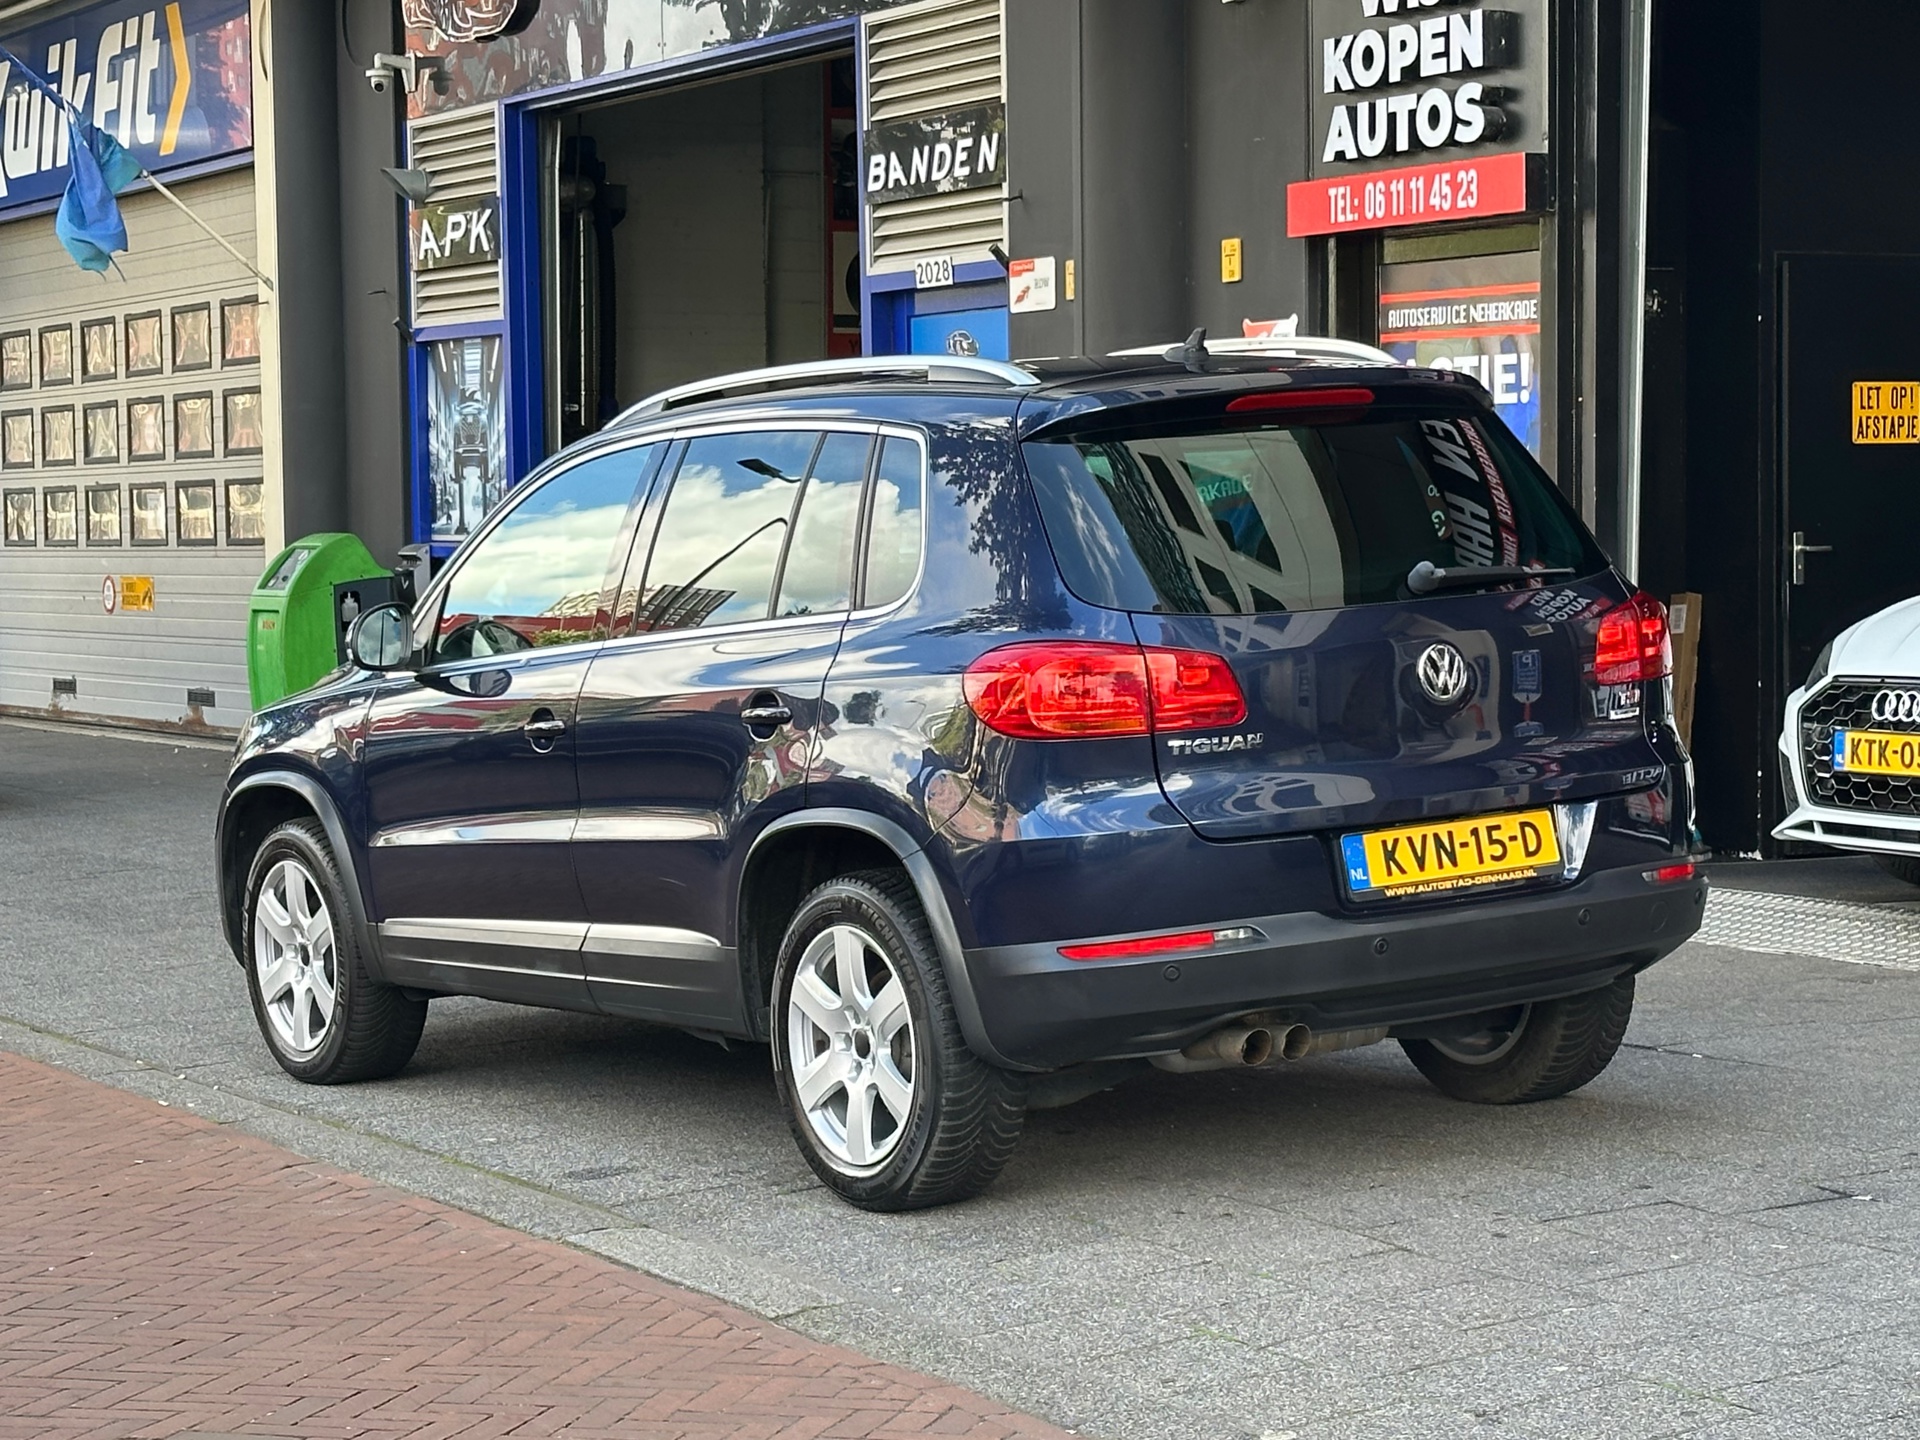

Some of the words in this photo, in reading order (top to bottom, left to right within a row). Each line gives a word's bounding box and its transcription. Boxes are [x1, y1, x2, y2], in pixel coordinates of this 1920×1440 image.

[1323, 8, 1484, 93] KOPEN
[0, 38, 91, 197] wik
[93, 11, 160, 149] Fit
[1322, 82, 1485, 163] AUTOS
[867, 133, 999, 192] BANDEN
[1328, 186, 1359, 224] TEL:
[1364, 181, 1386, 220] 06
[1389, 179, 1404, 216] 11
[1409, 177, 1424, 214] 11
[1429, 172, 1451, 211] 45
[1456, 169, 1478, 208] 23
[419, 209, 493, 261] APK
[916, 259, 951, 286] 2028
[1469, 299, 1538, 324] NEHERKADE
[1859, 386, 1881, 410] LET
[1891, 386, 1914, 410] OP!
[1857, 415, 1919, 439] AFSTAPJE
[1167, 733, 1264, 755] TIGUAN
[1850, 737, 1920, 770] KTK-0
[1351, 868, 1368, 881] NL
[1381, 821, 1542, 878] KVN-15-D
